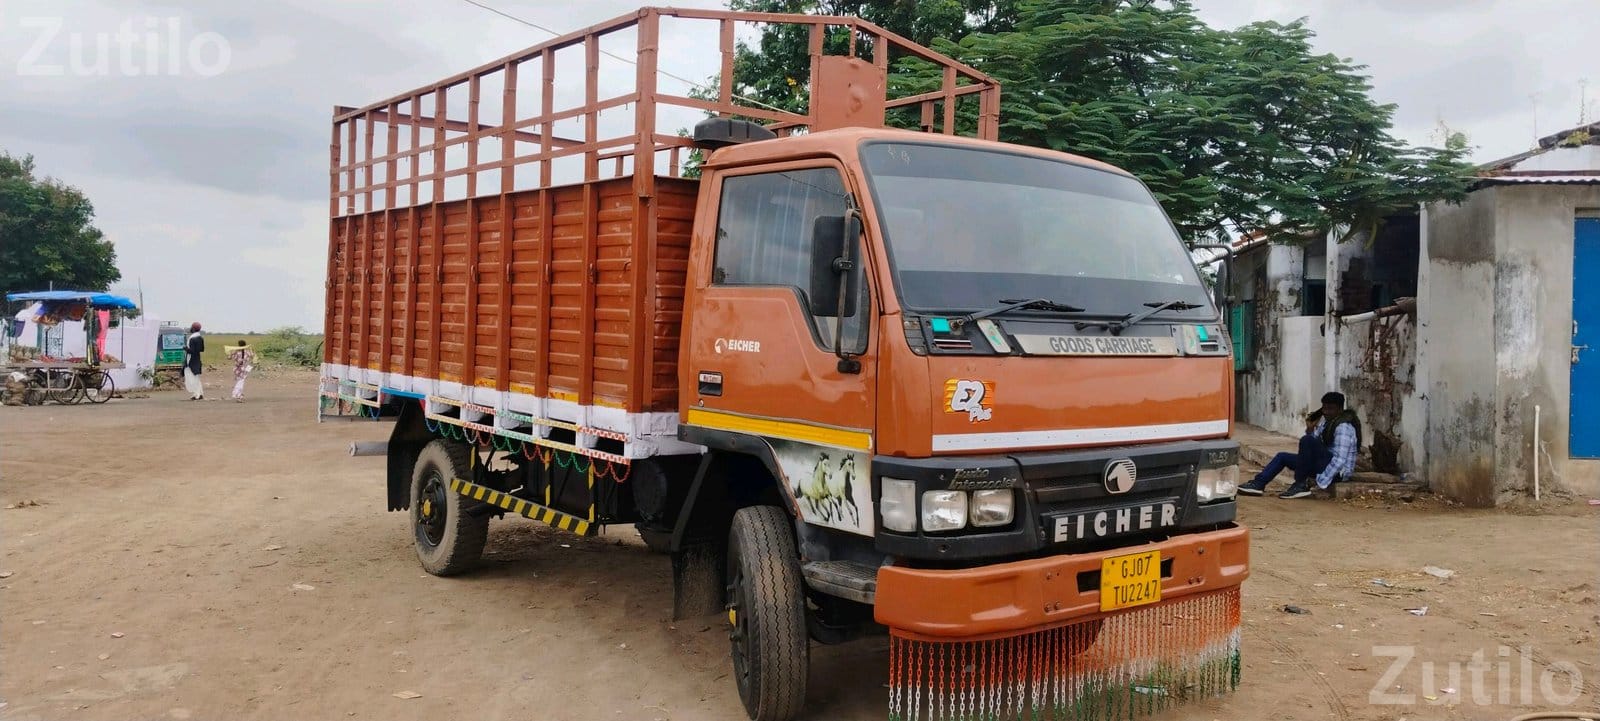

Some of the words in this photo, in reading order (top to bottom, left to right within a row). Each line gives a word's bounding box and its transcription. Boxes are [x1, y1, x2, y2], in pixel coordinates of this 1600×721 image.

[728, 340, 760, 353] EICHER
[1049, 337, 1095, 353] GOODS
[1096, 338, 1156, 353] CARRIAGE
[949, 477, 1017, 489] Intercooler
[1054, 503, 1175, 543] EICHER
[1121, 554, 1153, 578] GJ07
[1113, 580, 1158, 605] TU2247
